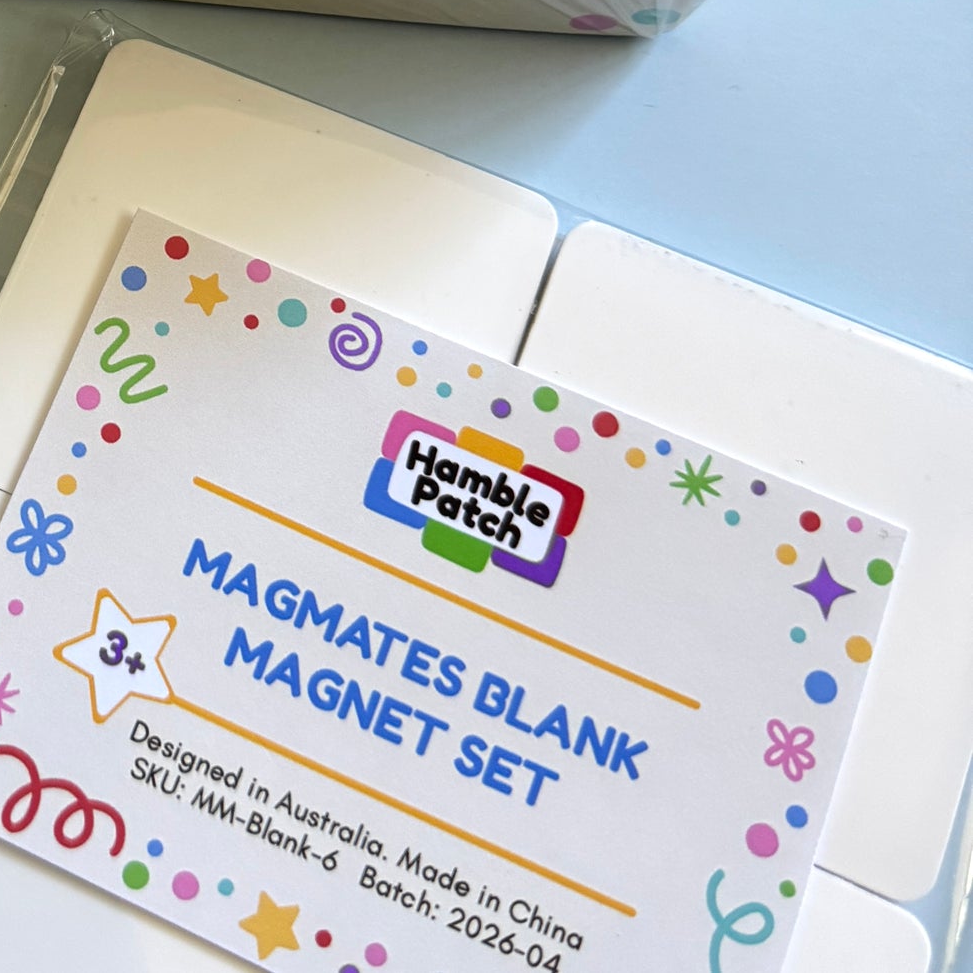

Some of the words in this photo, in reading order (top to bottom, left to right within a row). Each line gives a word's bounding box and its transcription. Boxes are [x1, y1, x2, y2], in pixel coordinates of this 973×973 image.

[405, 439, 550, 529] Hamble
[410, 477, 522, 551] Patch
[98, 630, 146, 675] 3+
[182, 538, 466, 696] MAGMATES
[473, 672, 648, 780] BLANK
[224, 627, 449, 756] MAGNET
[454, 734, 560, 806] SET
[130, 719, 243, 790] Designed
[247, 778, 270, 805] in
[275, 792, 388, 861] Australia.
[397, 848, 471, 898] Made
[477, 885, 501, 913] in
[508, 900, 584, 952] China
[130, 757, 187, 800] SKU:
[190, 789, 340, 872] MM-Blank-6
[359, 865, 440, 920] Batch:
[447, 907, 563, 973] 2026-04
